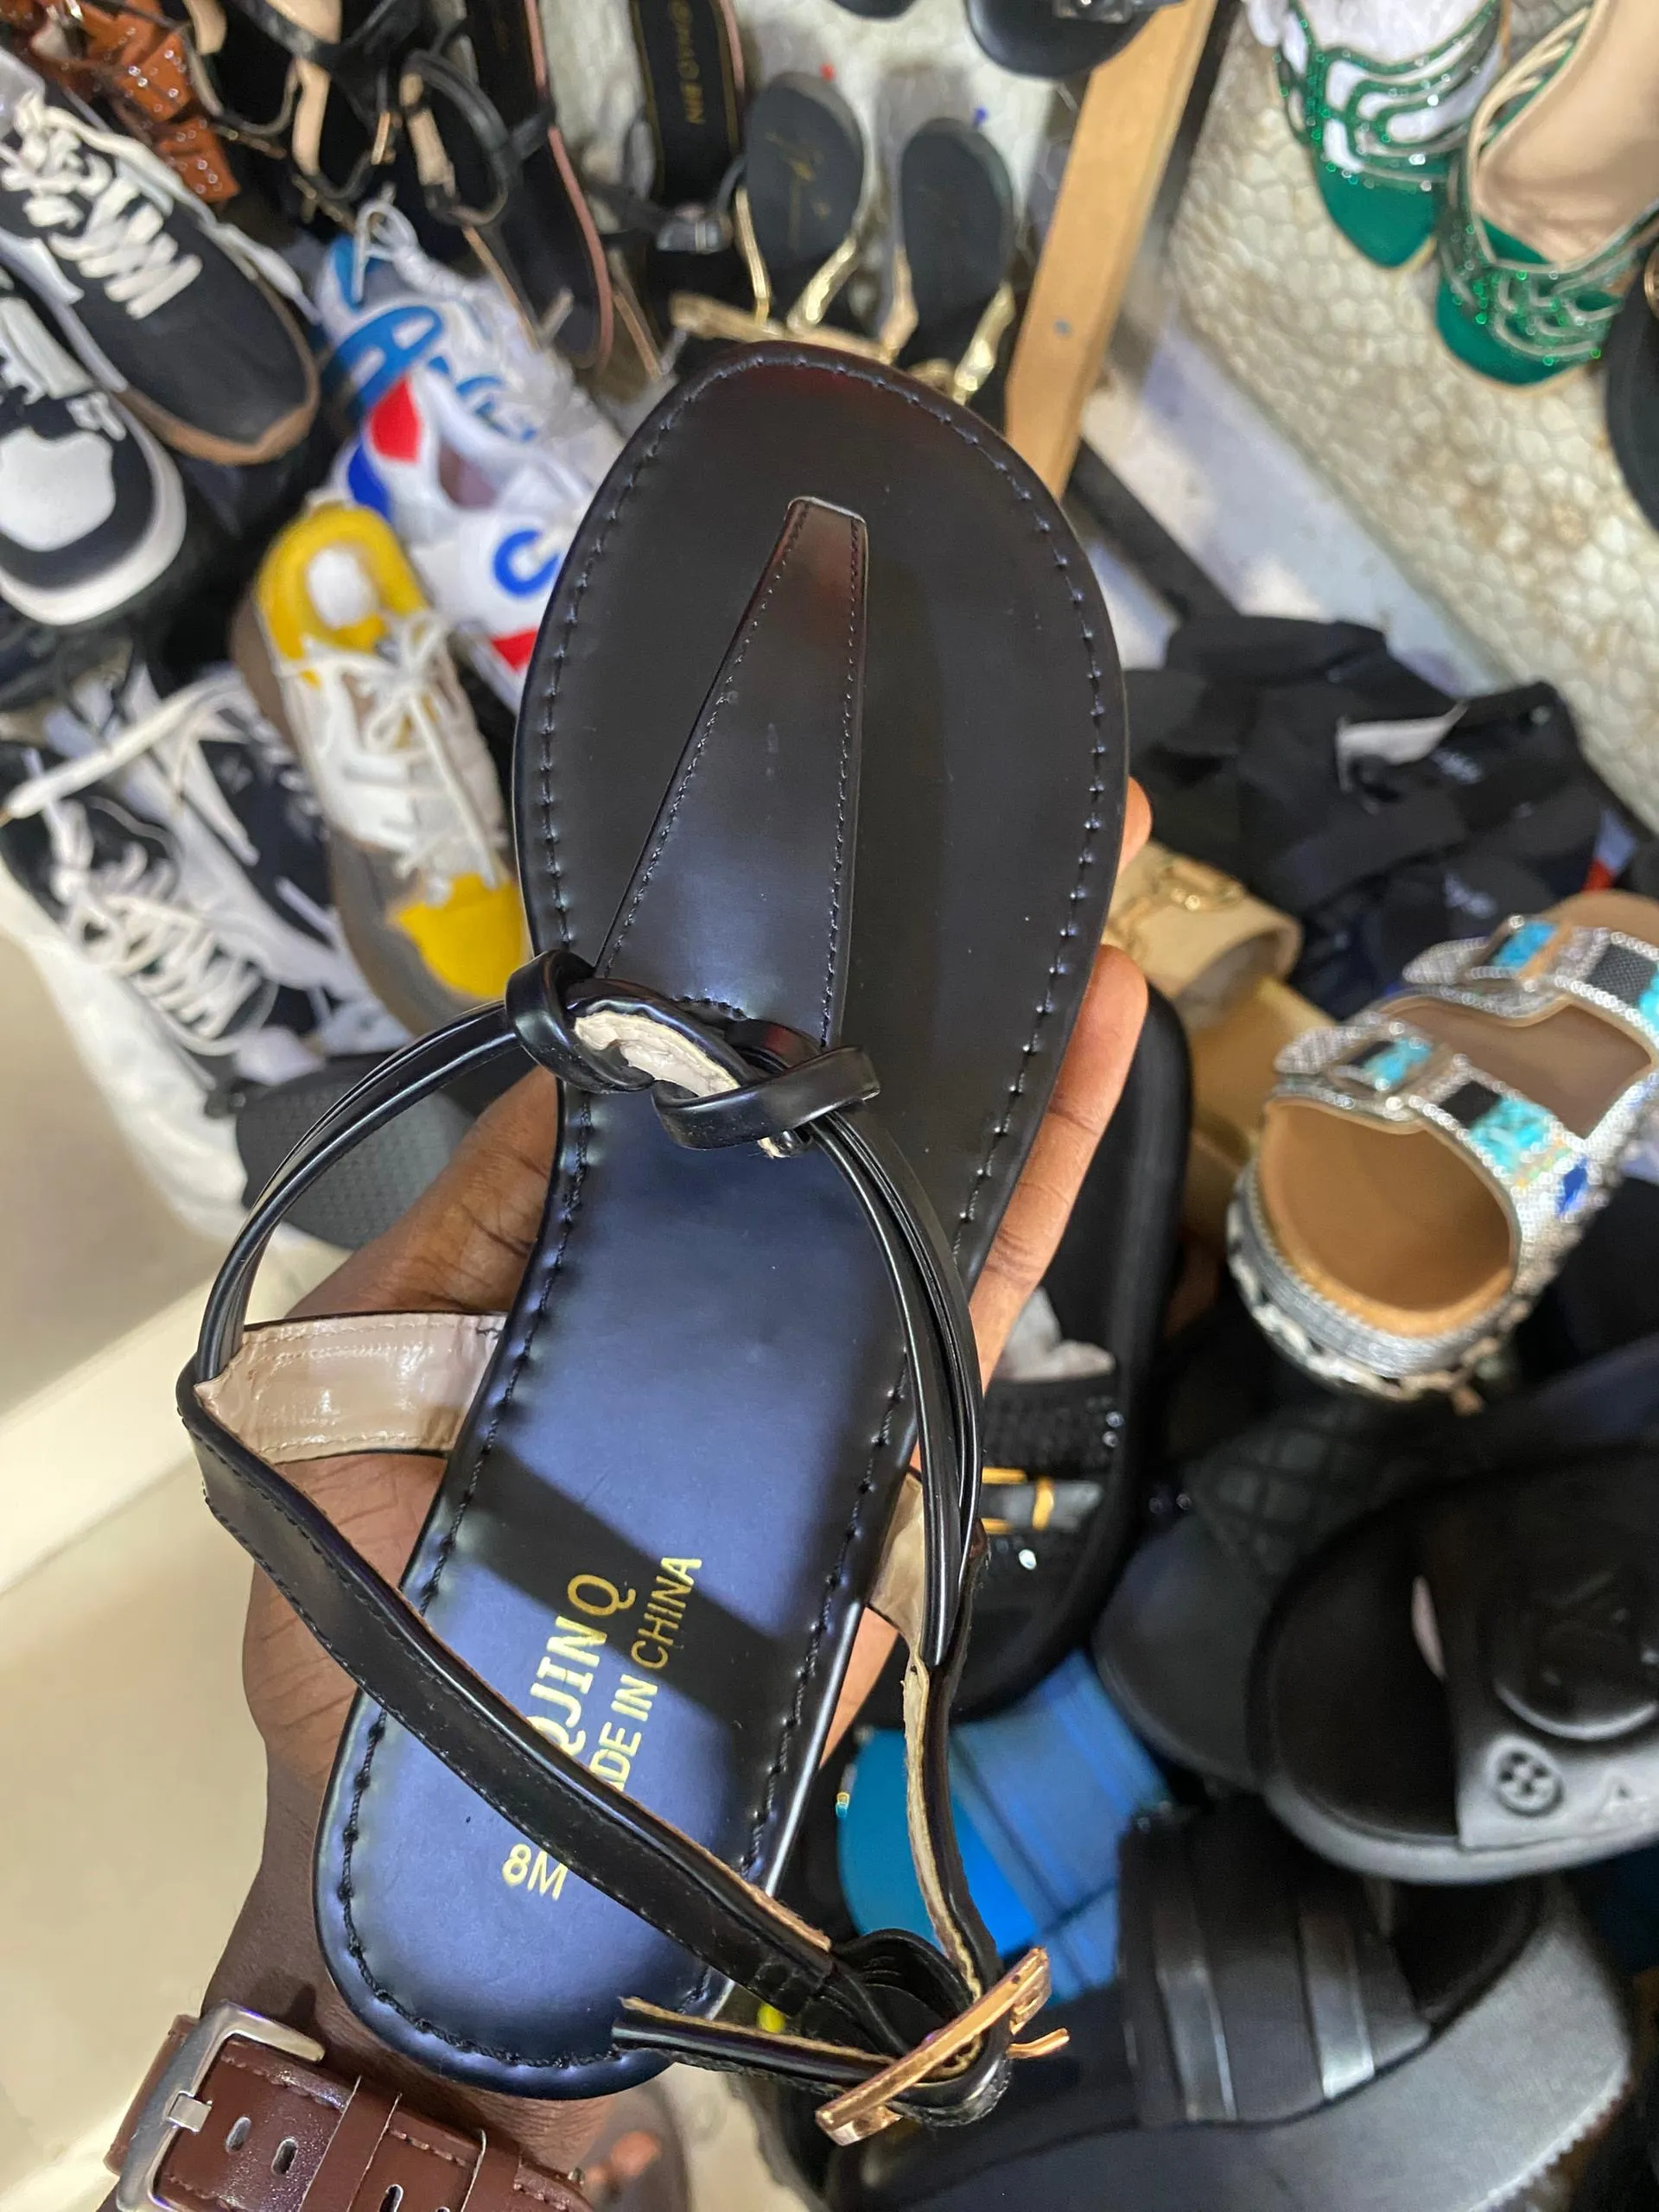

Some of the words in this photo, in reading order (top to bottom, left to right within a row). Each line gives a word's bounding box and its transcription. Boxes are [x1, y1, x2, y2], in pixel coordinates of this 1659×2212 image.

[631, 1557, 702, 1669] CHINA
[611, 1675, 658, 1721] IN
[588, 1721, 641, 1792] DE
[501, 1843, 568, 1901] 8M
